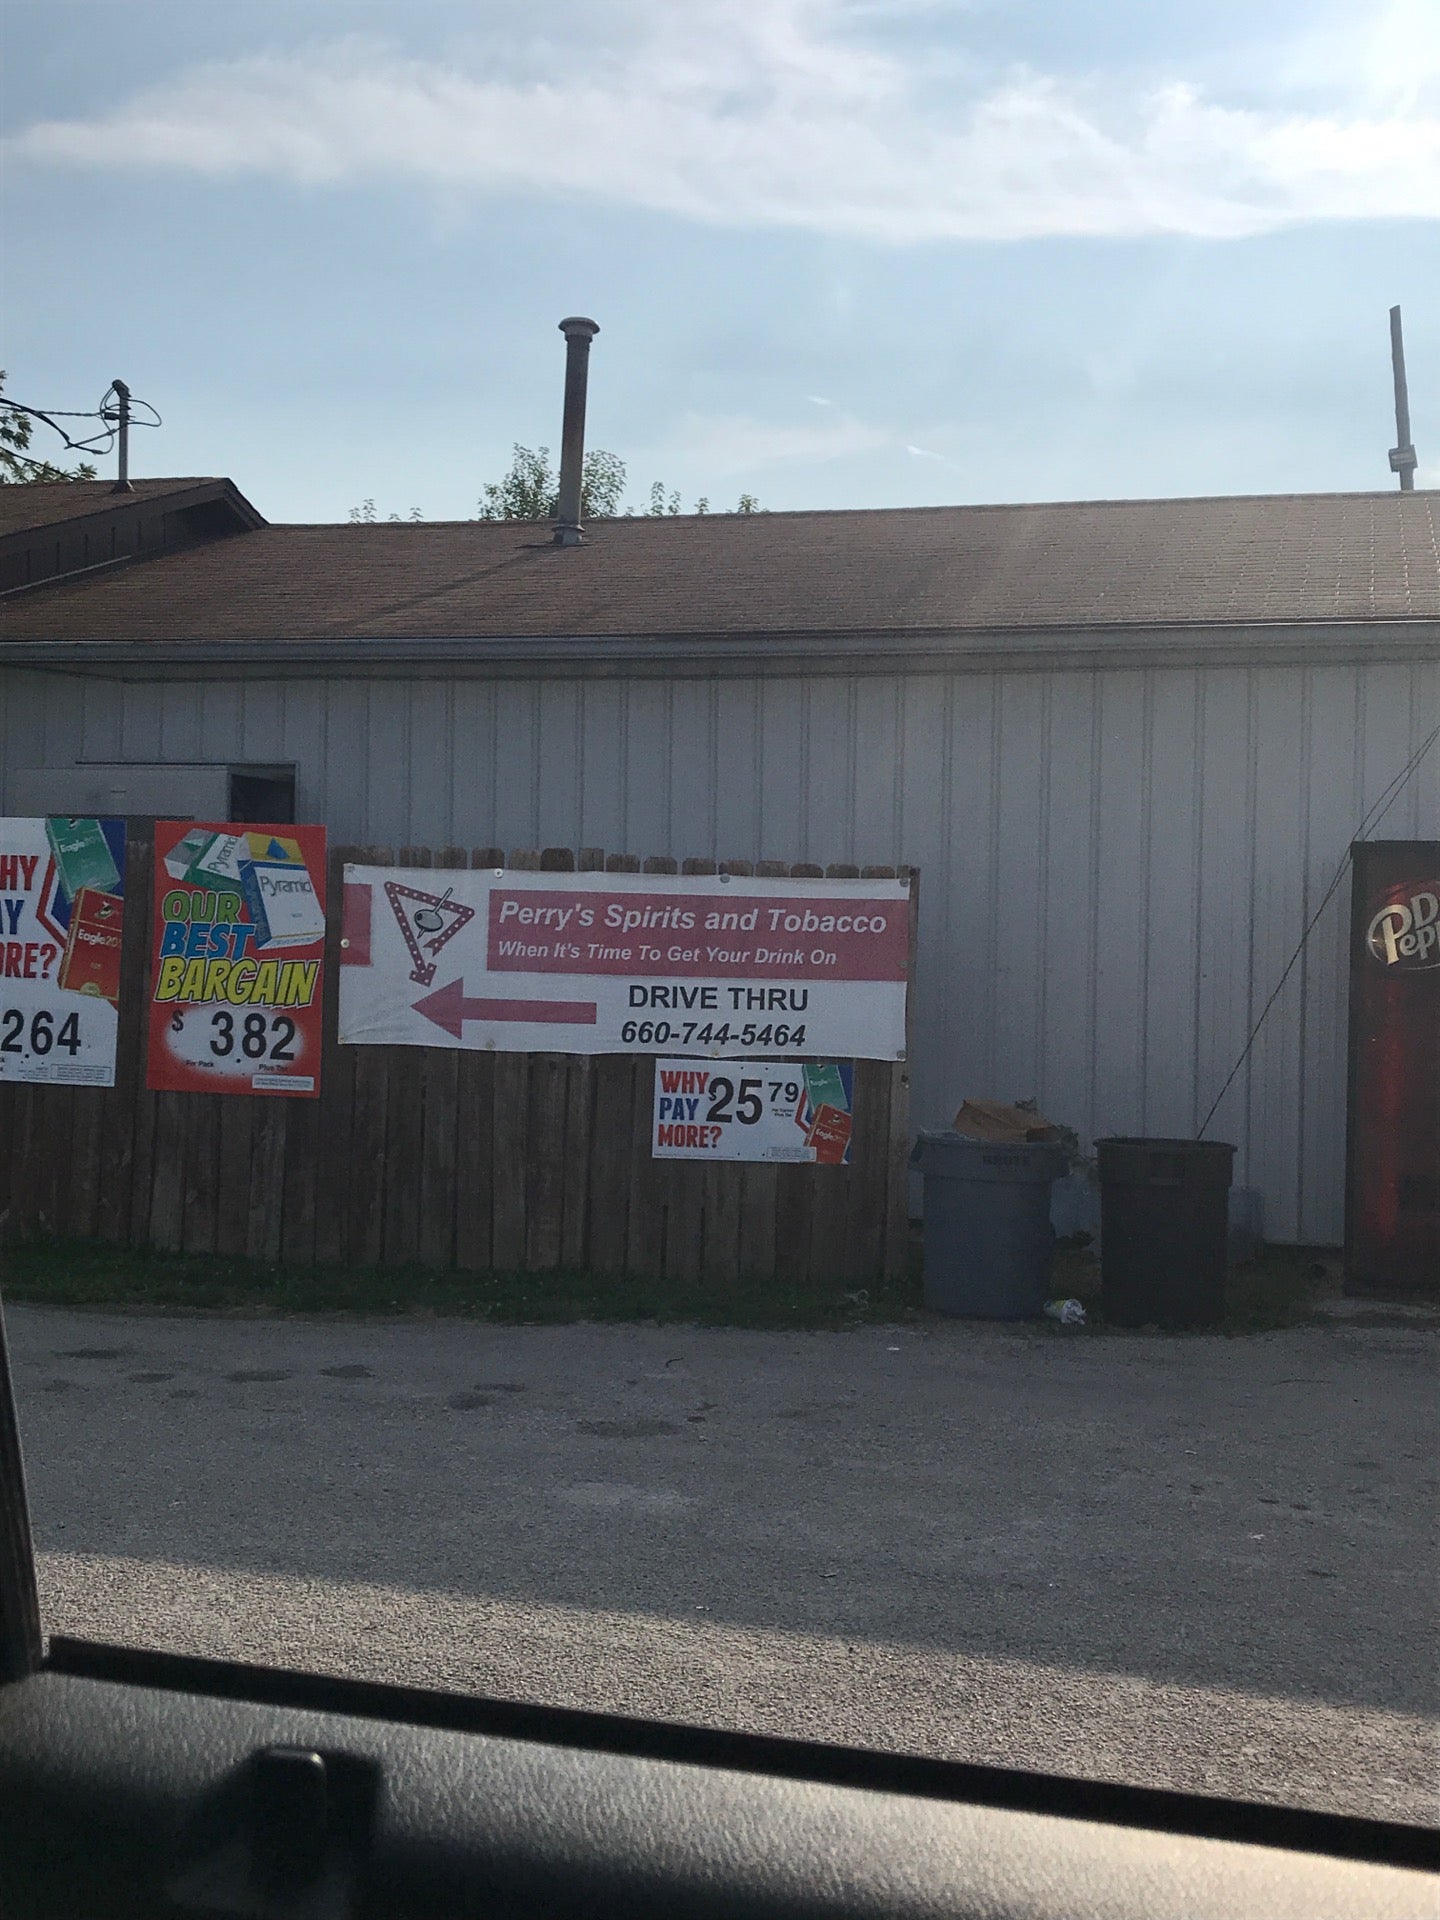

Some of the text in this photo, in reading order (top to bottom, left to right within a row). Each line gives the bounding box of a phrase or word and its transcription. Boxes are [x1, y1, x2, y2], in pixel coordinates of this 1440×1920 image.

[207, 837, 238, 872] Pyramid
[0, 855, 39, 891] HY
[259, 875, 314, 896] Pyramid
[163, 890, 242, 924] OUR
[499, 901, 887, 933] Perry's Spirits and Tobacco
[1410, 892, 1440, 929] D
[161, 921, 258, 959] BEST
[499, 941, 837, 965] When It's Time To Get Your Drink On
[153, 957, 321, 1009] BARGAIN
[629, 985, 808, 1011] DRIVE THRU
[171, 1009, 184, 1034] $
[621, 1020, 806, 1046] 660-744-5464
[660, 1070, 710, 1094] WHY
[768, 1082, 799, 1103] 79
[659, 1097, 699, 1121] PAY
[658, 1124, 723, 1149] MORE?
